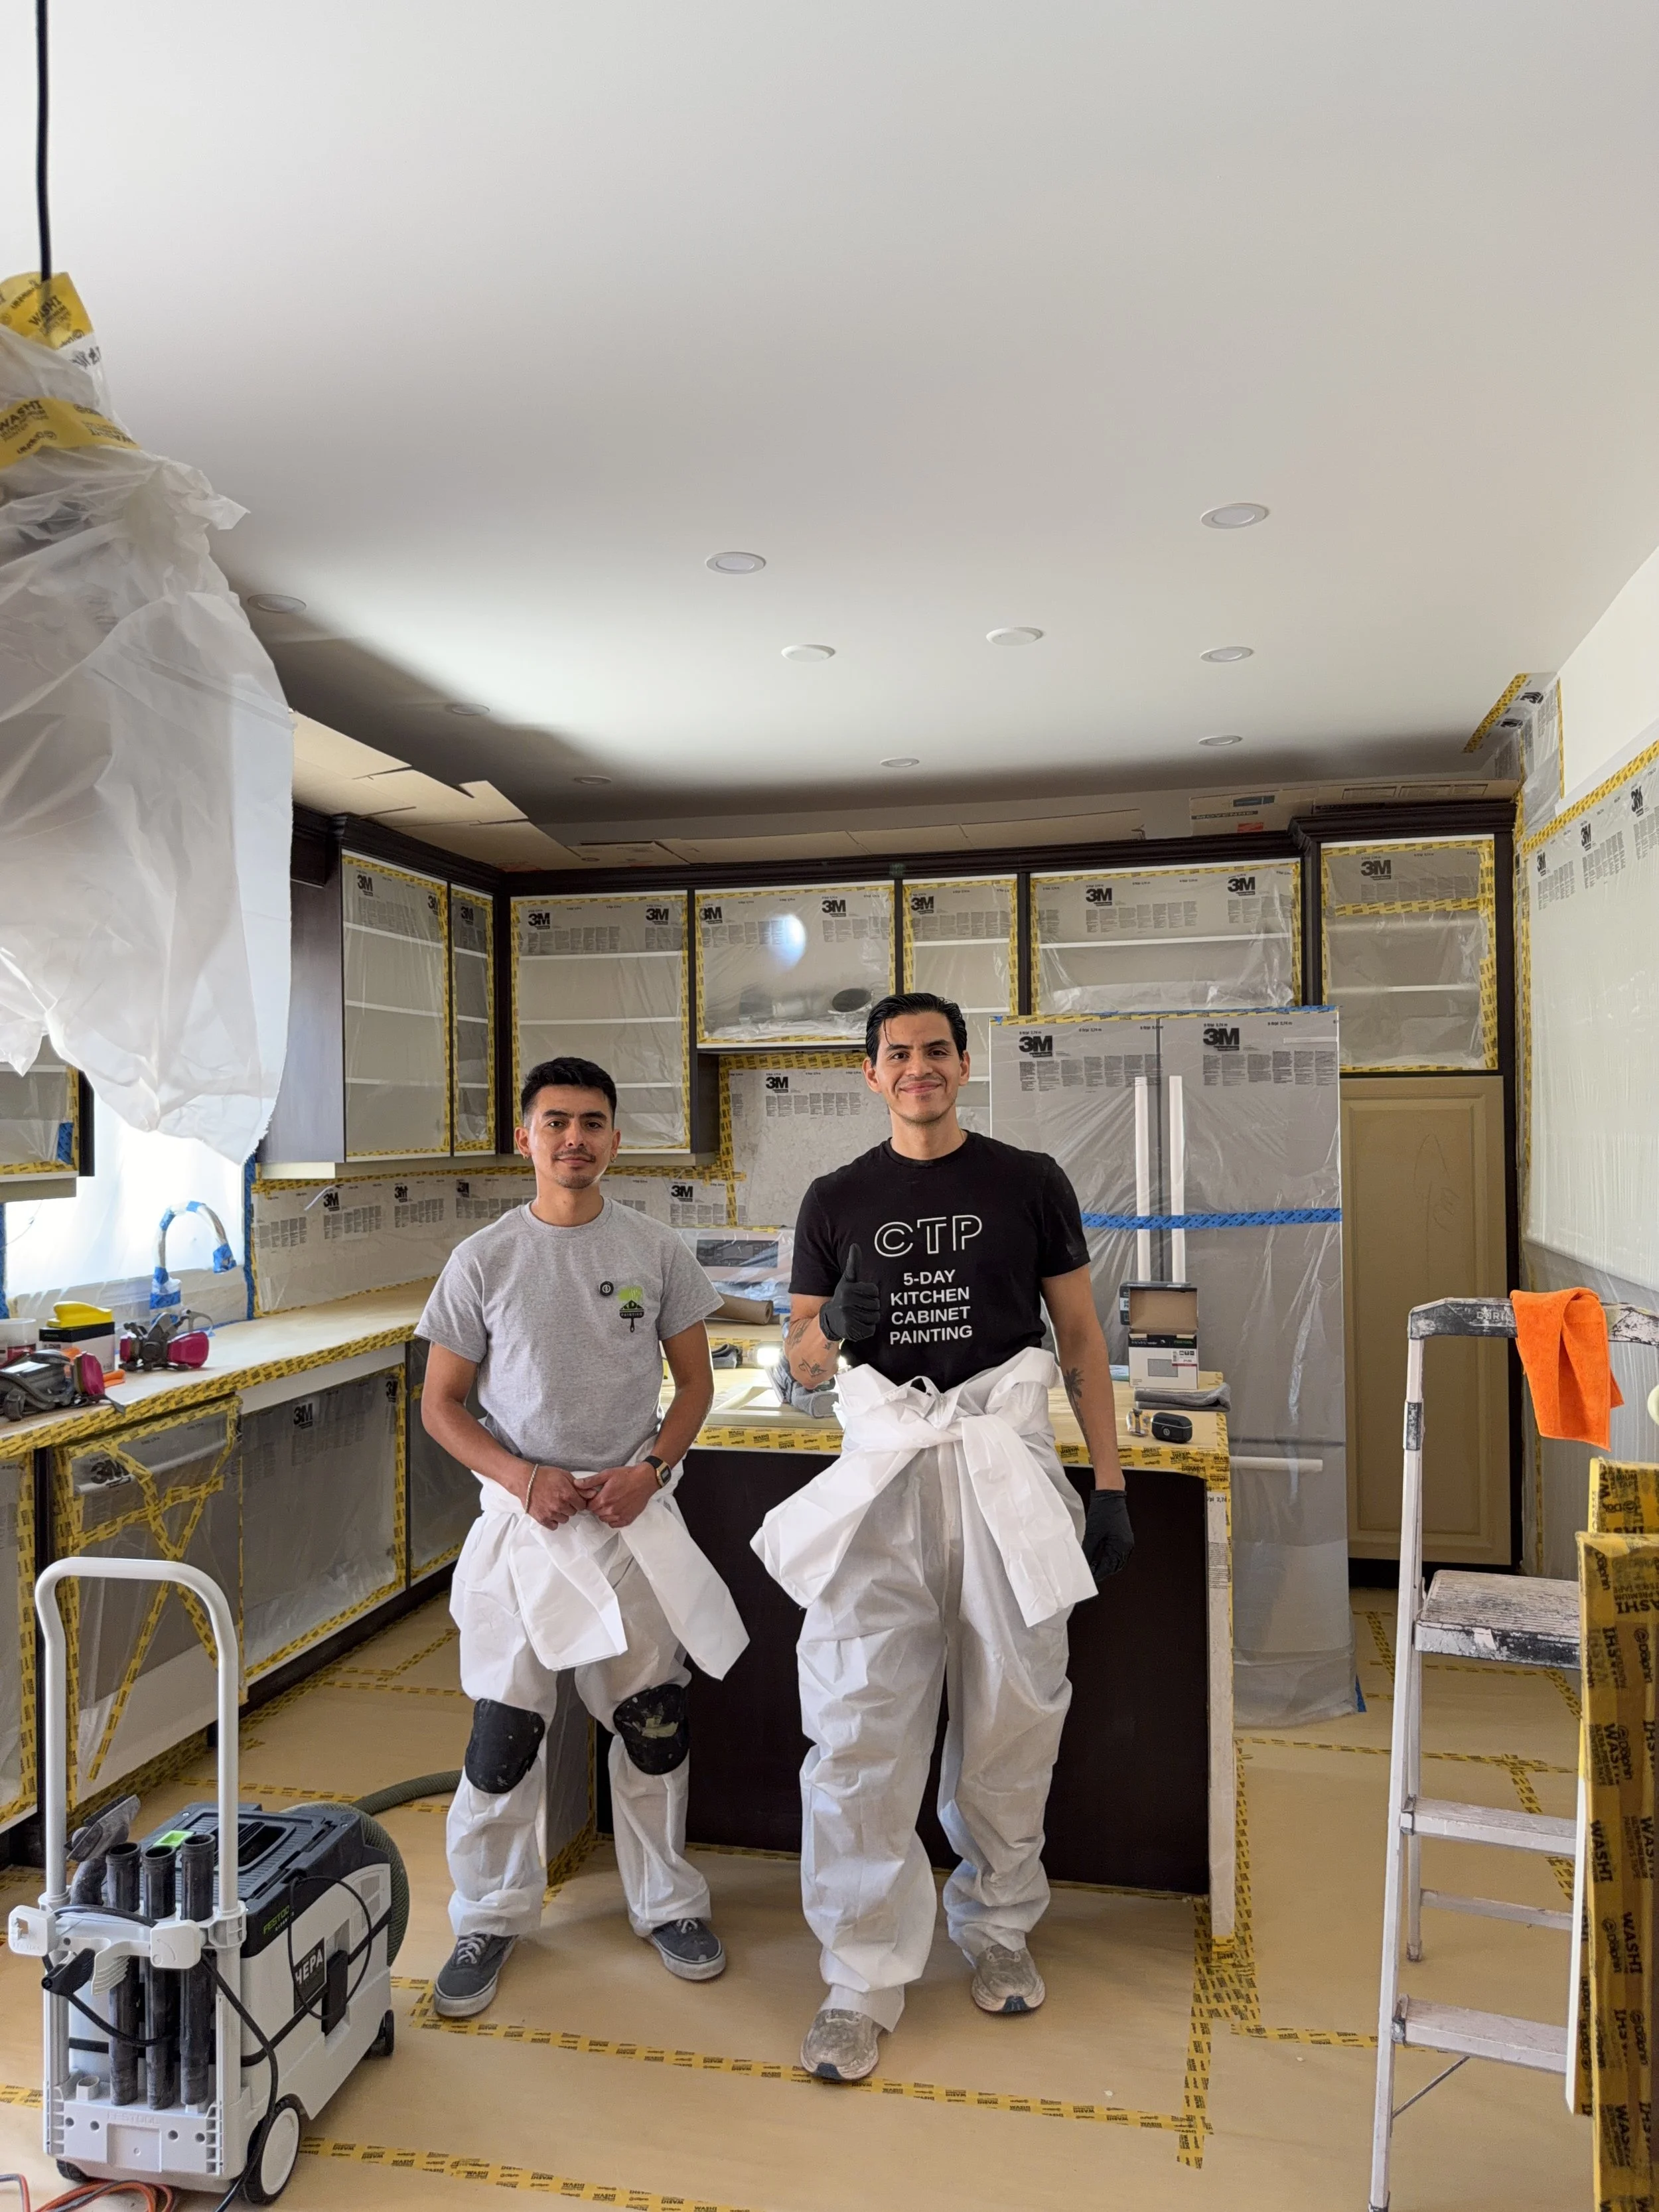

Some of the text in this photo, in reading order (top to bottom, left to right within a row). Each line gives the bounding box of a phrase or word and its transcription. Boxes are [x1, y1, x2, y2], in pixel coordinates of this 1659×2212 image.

[1631, 786, 1642, 812] 3M
[1581, 824, 1591, 847] 3M
[1361, 860, 1391, 875] 3M
[1537, 851, 1546, 873] 3M
[357, 874, 373, 891] 3M
[1228, 877, 1255, 891] 3M
[1086, 888, 1112, 902] 3M
[822, 900, 845, 913] 3M
[912, 897, 934, 911] 3M
[461, 907, 473, 921] 3M
[528, 913, 551, 926] 3M
[646, 909, 669, 921] 3M
[699, 907, 722, 921] 3M
[1019, 1035, 1052, 1053] 3M
[1203, 1027, 1239, 1046] 3M
[766, 1076, 788, 1090] 3M
[395, 1185, 408, 1199] 3M
[671, 1185, 693, 1199] 3M
[323, 1193, 339, 1209] 3M
[874, 1215, 982, 1257] CTP
[903, 1269, 956, 1286] 5-DAY
[891, 1286, 970, 1306] KITCHEN
[891, 1306, 971, 1325] CABINET
[889, 1325, 972, 1345] PAINTING
[293, 1403, 313, 1425] 3M
[1615, 1599, 1659, 1614] ASHI
[1638, 1643, 1654, 1684] Dolphin
[1619, 1741, 1634, 1780] Dolphin
[1591, 1820, 1613, 1882] WASHI
[1623, 1912, 1643, 1974] WASHI
[1607, 1933, 1622, 1972] Dolphin
[295, 1949, 323, 1985] HEPA
